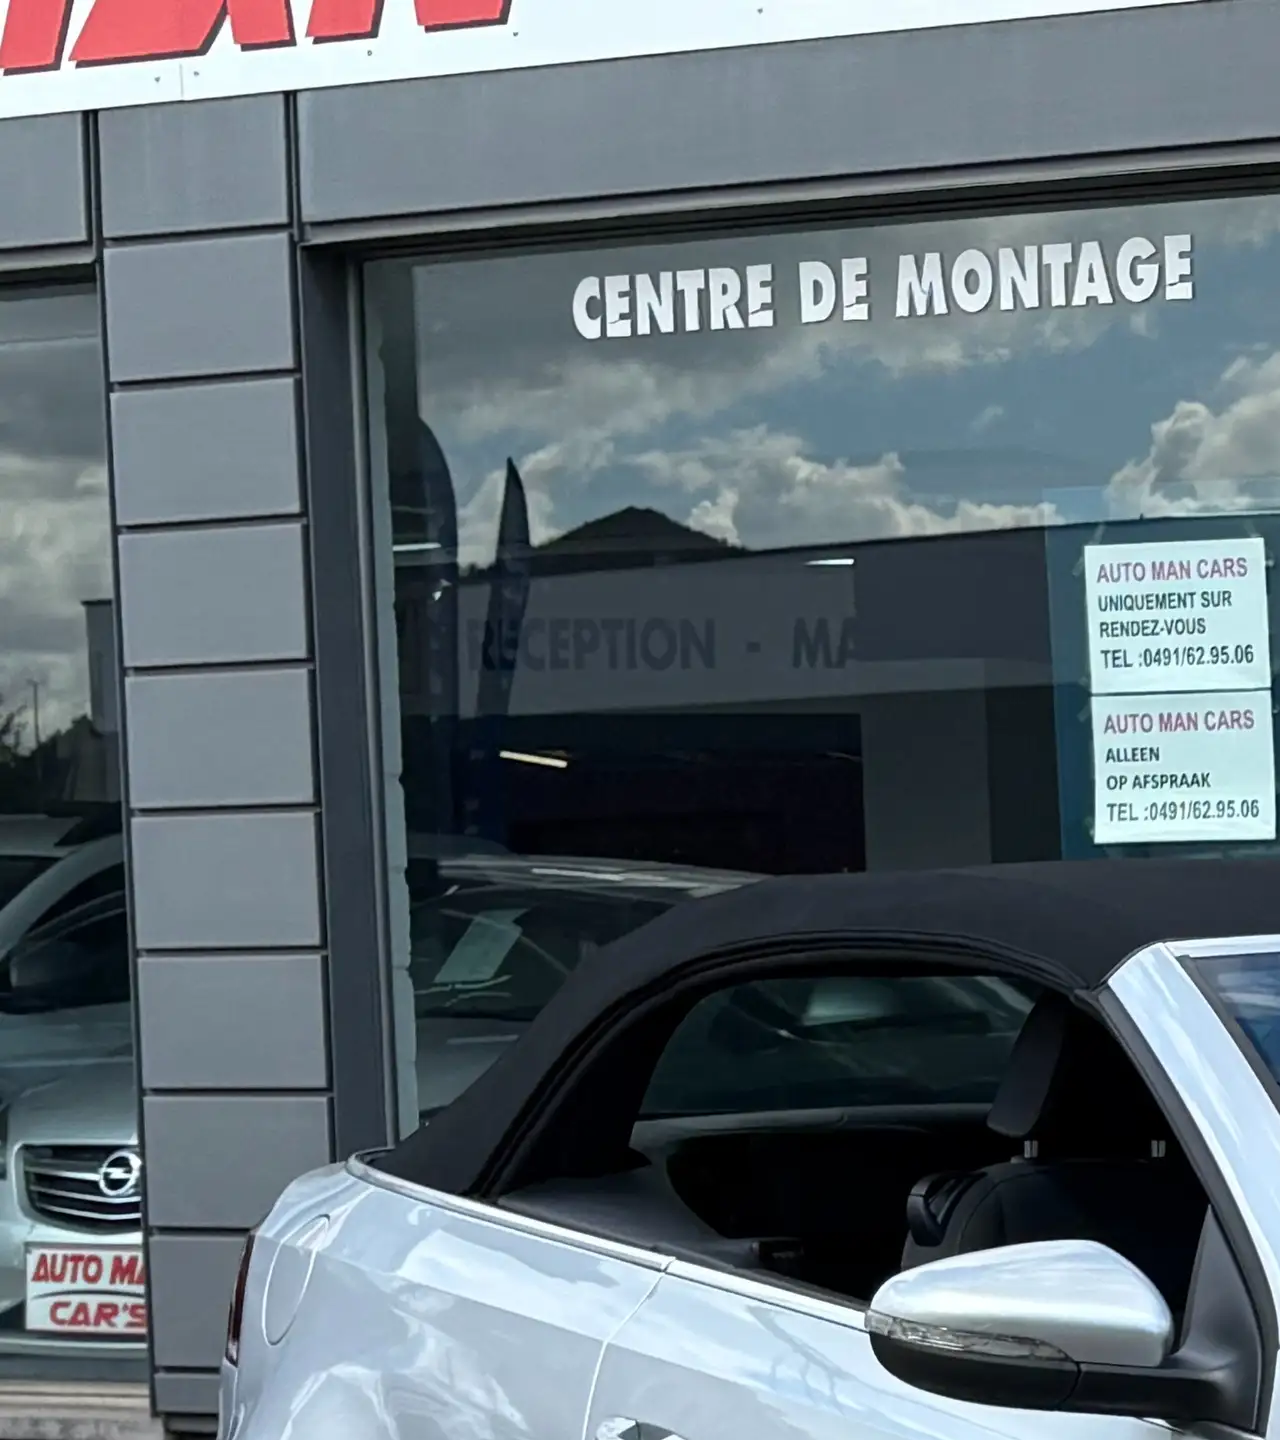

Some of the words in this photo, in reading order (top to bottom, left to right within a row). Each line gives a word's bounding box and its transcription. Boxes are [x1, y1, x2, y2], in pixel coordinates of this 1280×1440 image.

[572, 262, 774, 340] CENTRE
[799, 257, 869, 324] DE
[894, 233, 1195, 318] MONTAGE
[1096, 562, 1146, 584] AUTO
[1151, 560, 1192, 582] MAN
[1196, 557, 1248, 580] CARS
[1097, 591, 1197, 613] UNIQUEMENT
[1201, 590, 1233, 608] SUR
[1099, 617, 1207, 639] RENDEZ-VOUS
[1103, 713, 1154, 735] AUTO
[1158, 711, 1199, 733] MAN
[1204, 709, 1255, 731] CARS
[1105, 746, 1161, 764] ALLEEN
[1106, 774, 1128, 791] OP
[1131, 772, 1212, 790] AFSPRAAK
[32, 1253, 103, 1284] AUTO
